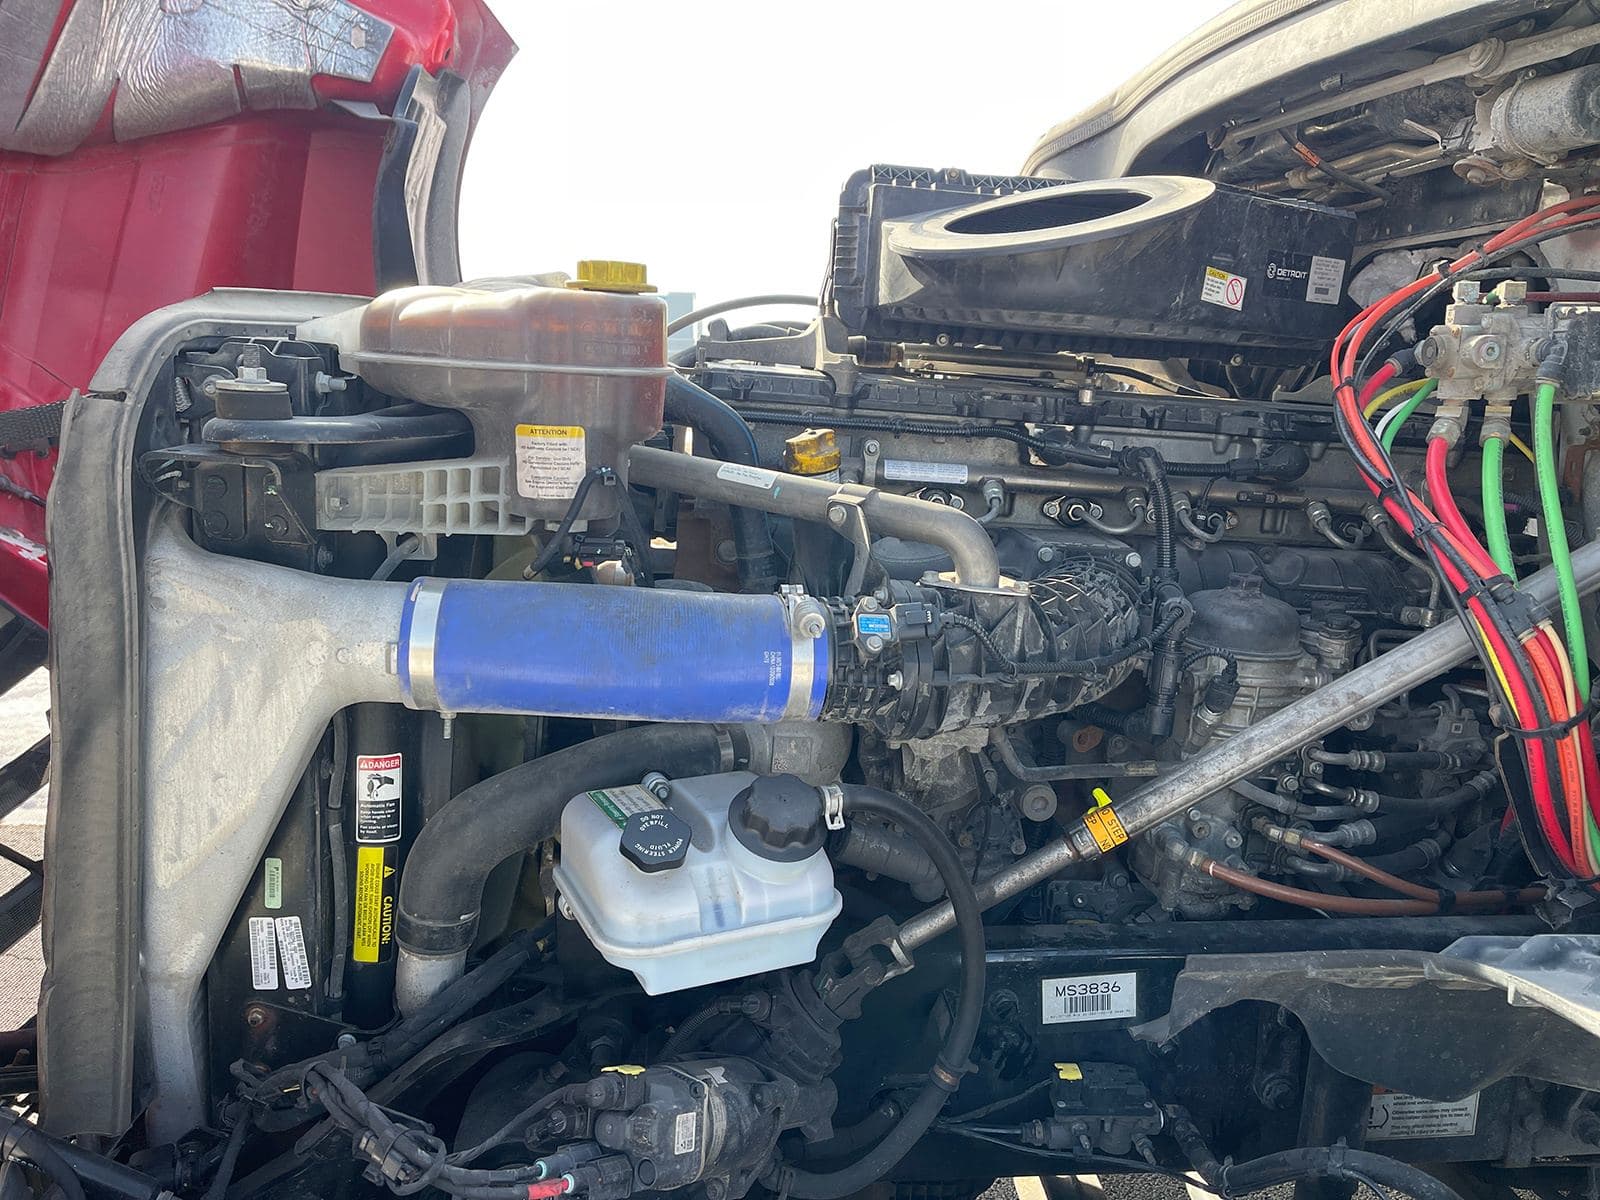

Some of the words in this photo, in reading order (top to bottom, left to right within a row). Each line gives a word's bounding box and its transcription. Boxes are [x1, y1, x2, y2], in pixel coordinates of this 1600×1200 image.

[1277, 269, 1308, 279] DETROIT
[369, 760, 400, 769] DANGER
[1107, 818, 1125, 839] STEP
[634, 843, 666, 857] STEERING
[650, 842, 672, 851] FLUID
[381, 896, 393, 945] CAUTION:
[1056, 981, 1121, 997] MS3836
